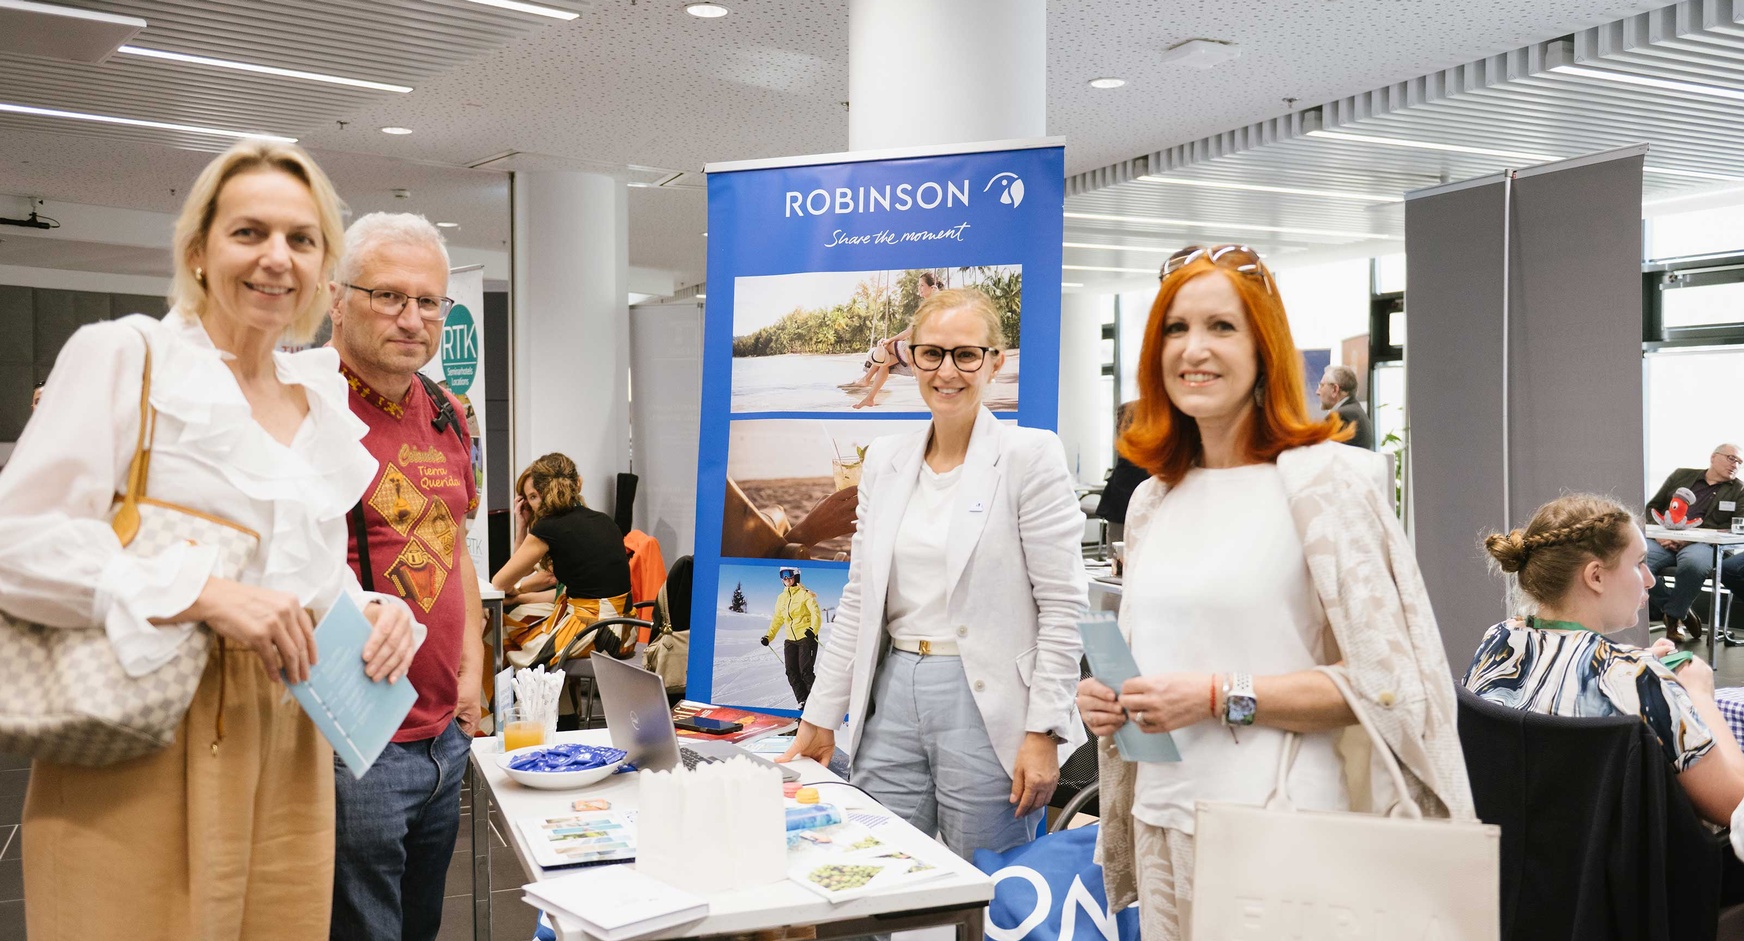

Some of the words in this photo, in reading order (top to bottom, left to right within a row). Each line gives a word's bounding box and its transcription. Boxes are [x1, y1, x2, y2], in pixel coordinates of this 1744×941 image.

[785, 180, 970, 218] ROBINSON
[824, 229, 871, 247] Share
[874, 231, 899, 245] the
[900, 221, 971, 243] moment
[442, 323, 477, 361] RTK
[447, 367, 473, 376] Seminarhotels
[451, 377, 469, 386] Locations
[417, 465, 448, 476] Tierra
[420, 475, 461, 490] Querida
